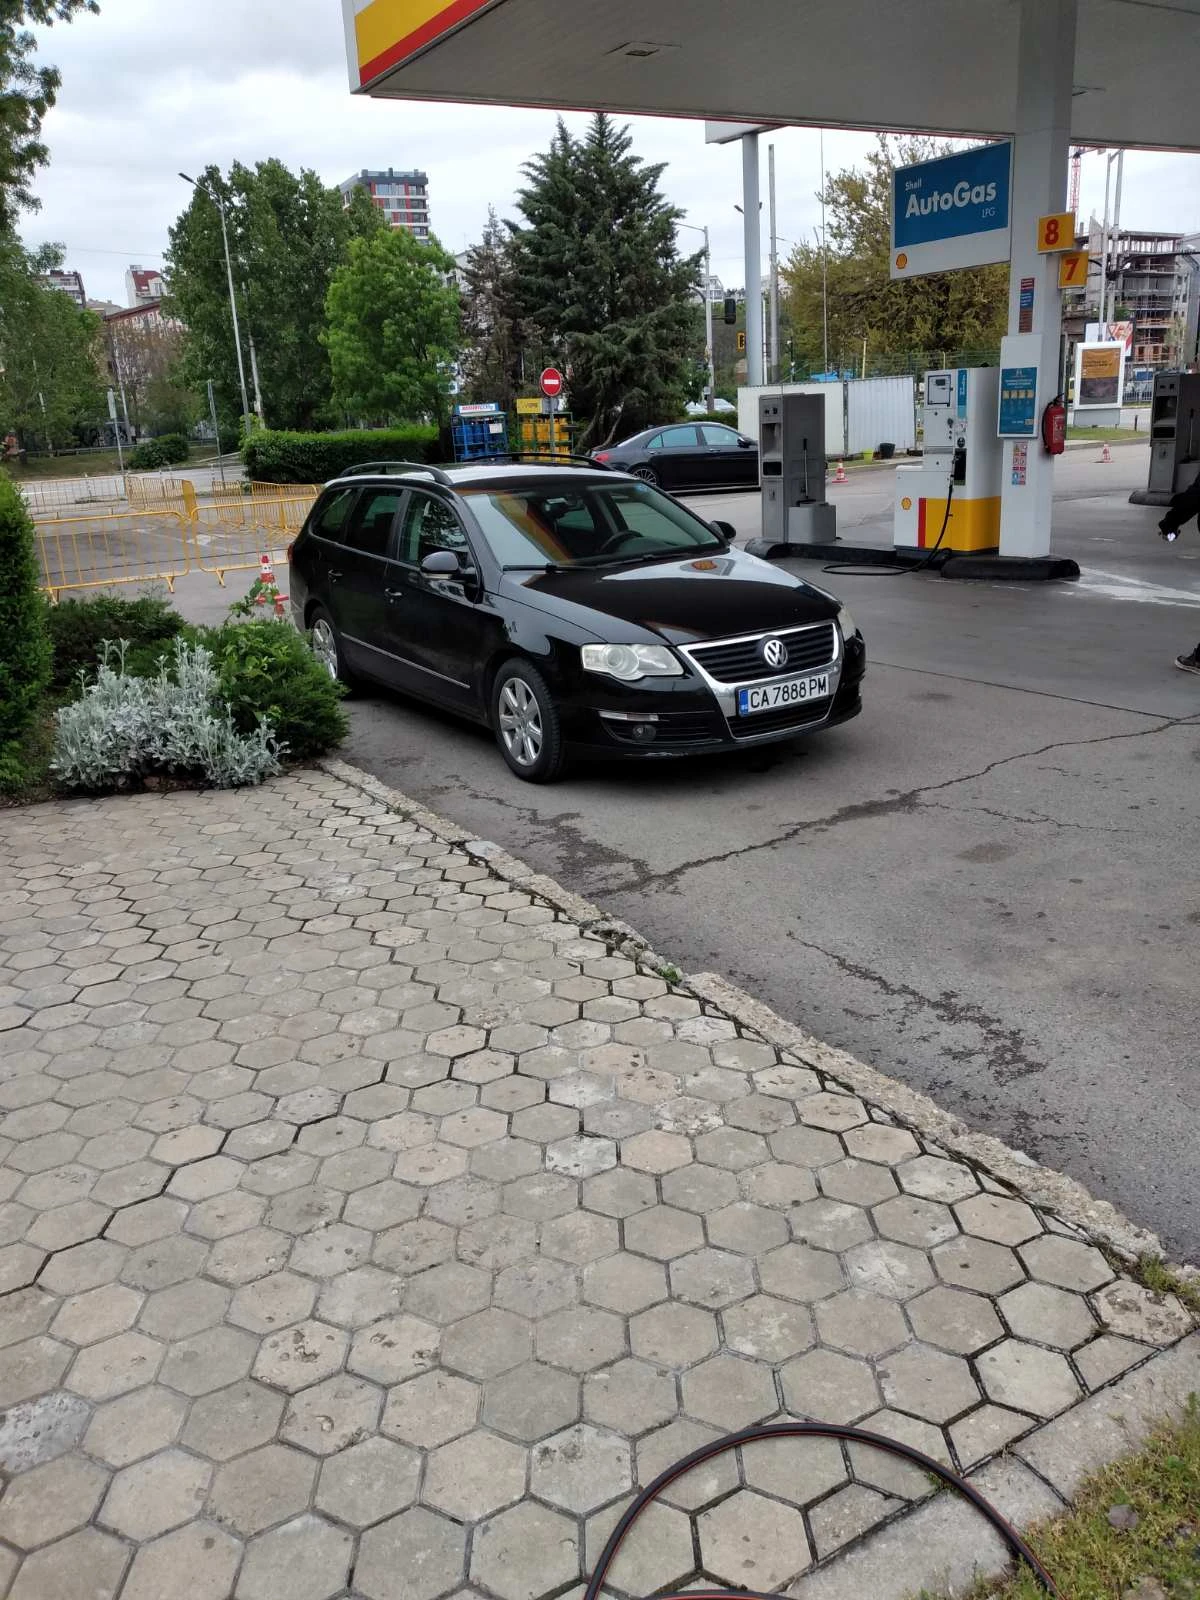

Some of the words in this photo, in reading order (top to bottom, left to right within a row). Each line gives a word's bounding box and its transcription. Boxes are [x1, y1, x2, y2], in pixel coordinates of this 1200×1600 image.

[905, 178, 922, 191] Shell
[905, 181, 997, 218] AutoGas
[981, 207, 996, 218] LPG
[1045, 218, 1059, 245] 8
[1065, 258, 1079, 281] 7
[750, 690, 770, 709] CA
[773, 681, 807, 705] 7888
[809, 676, 827, 696] PM
